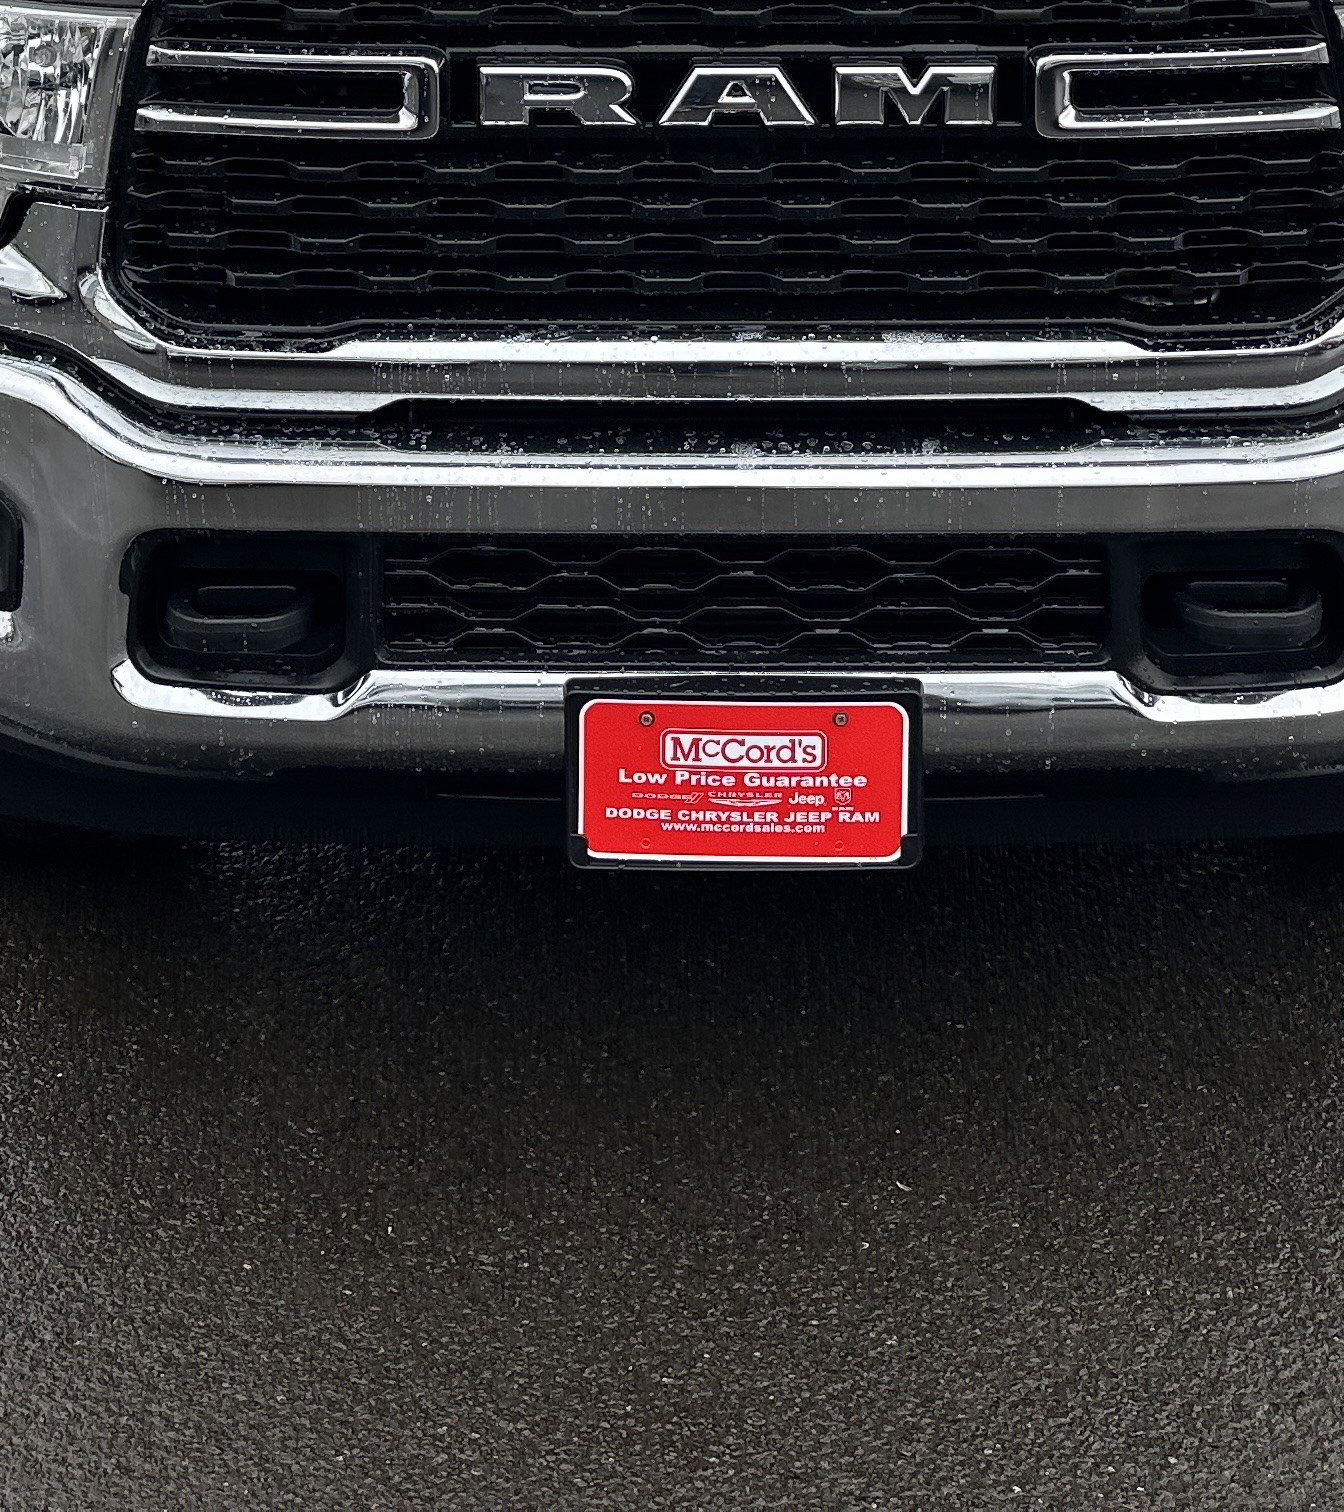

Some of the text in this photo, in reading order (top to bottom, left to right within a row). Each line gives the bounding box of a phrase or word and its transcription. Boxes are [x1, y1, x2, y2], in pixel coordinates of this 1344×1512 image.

[478, 65, 997, 126] RAM
[670, 736, 817, 764] McCord's
[618, 768, 868, 788] Low Price Guarantee
[707, 790, 783, 799] CHRYSLER
[788, 791, 825, 807] Jeep
[605, 807, 880, 824] DODGE CHRYSLER JEEP RAM
[660, 821, 826, 834] www.mccordsales.com
